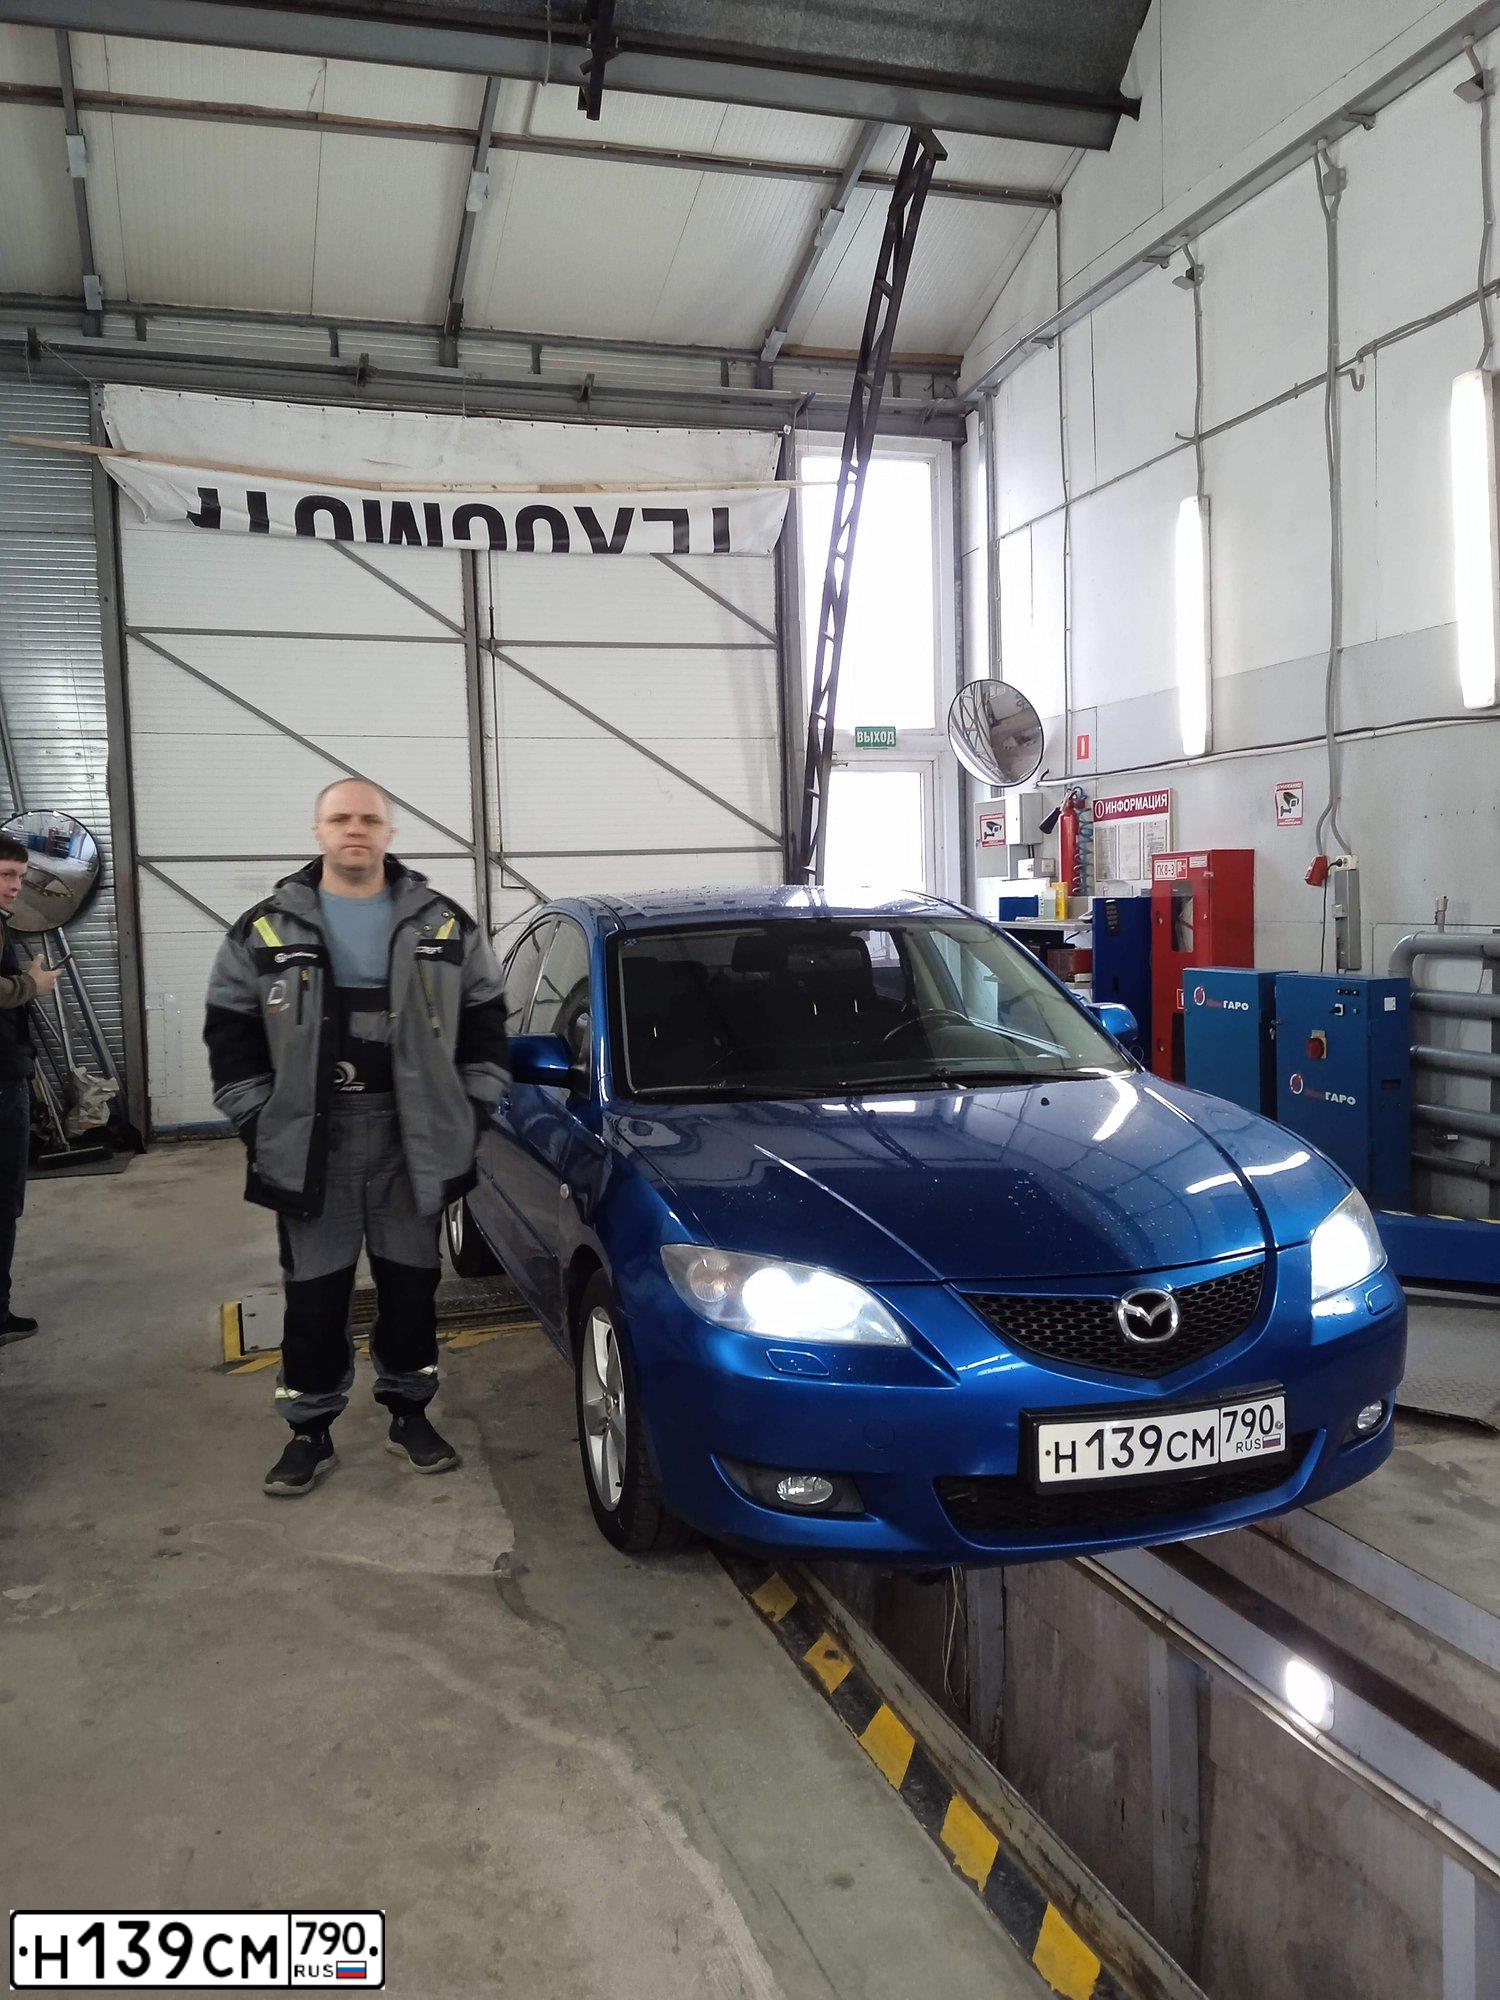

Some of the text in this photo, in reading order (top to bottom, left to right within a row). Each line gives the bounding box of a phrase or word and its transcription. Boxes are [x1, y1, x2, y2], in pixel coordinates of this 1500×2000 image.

[857, 731, 895, 745] ВЫХОД
[1105, 794, 1168, 814] ИНФОРМАЦИЯ
[1054, 1404, 1275, 1474] Н139СМ 790
[1235, 1438, 1262, 1453] RUS
